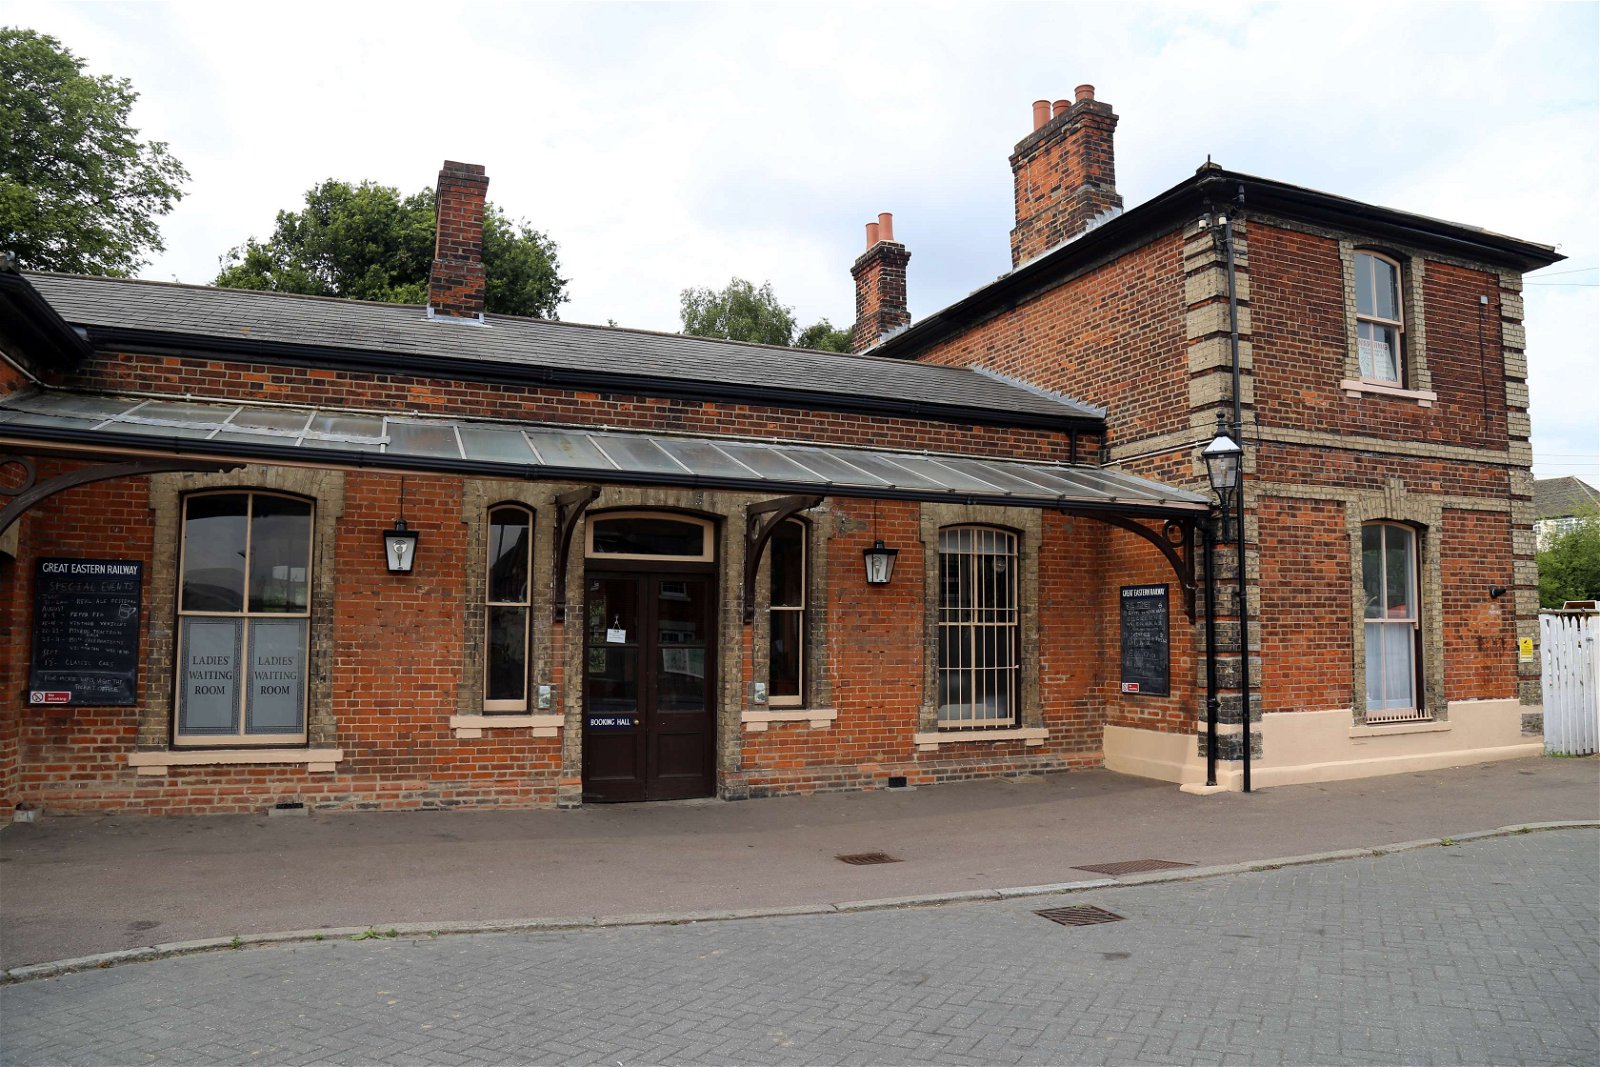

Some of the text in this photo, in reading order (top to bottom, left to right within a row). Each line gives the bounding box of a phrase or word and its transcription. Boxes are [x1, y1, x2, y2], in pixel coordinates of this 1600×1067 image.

[42, 562, 138, 575] GREAT EASTERN RAILWAY
[49, 581, 135, 592] SPECIAL EVENTS
[189, 670, 233, 680] WAITING
[254, 671, 297, 680] WAITING
[194, 685, 225, 695] ROOM
[260, 685, 290, 695] ROOM
[590, 718, 631, 726] BOOKING HALL
